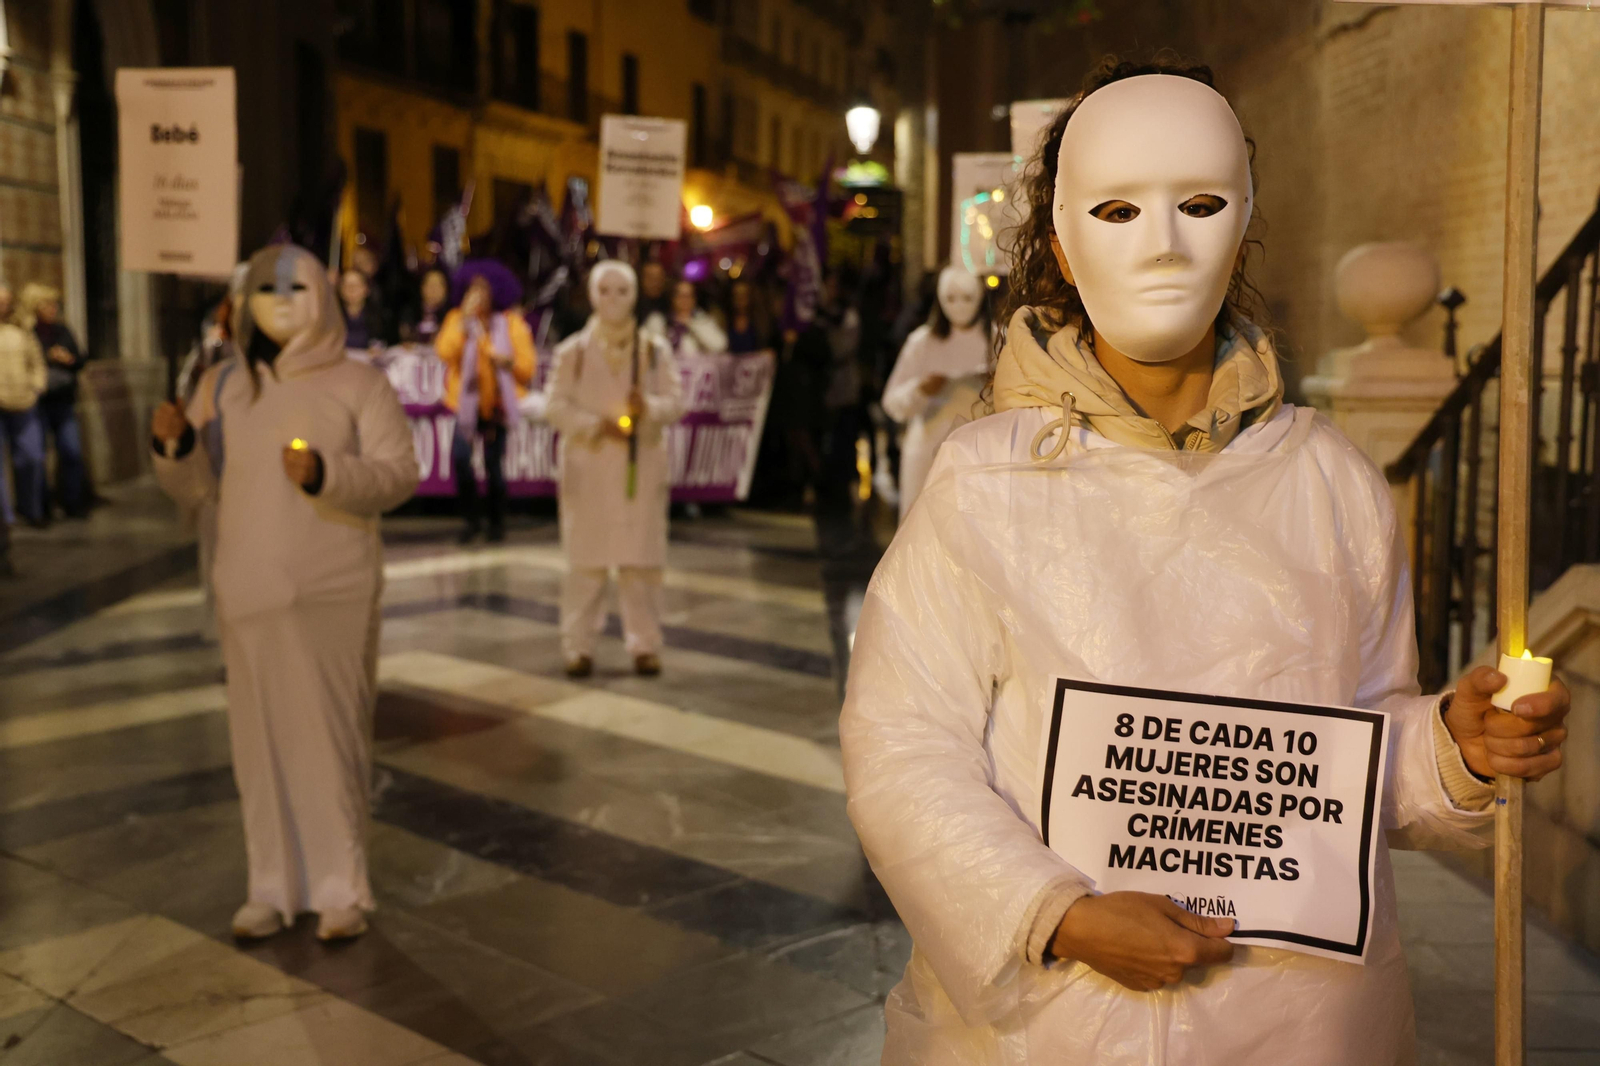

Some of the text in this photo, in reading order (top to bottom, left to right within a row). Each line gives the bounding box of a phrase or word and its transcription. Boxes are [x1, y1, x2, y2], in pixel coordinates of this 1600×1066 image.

[1114, 713, 1317, 756] 8 DE CADA 10
[1104, 744, 1319, 788] MUJERES SON
[1071, 774, 1344, 824] ASESINADAS POR
[1127, 809, 1284, 849] CRÍMENES
[1107, 843, 1300, 881] MACHISTAS
[1165, 894, 1237, 917] MPAÑA
